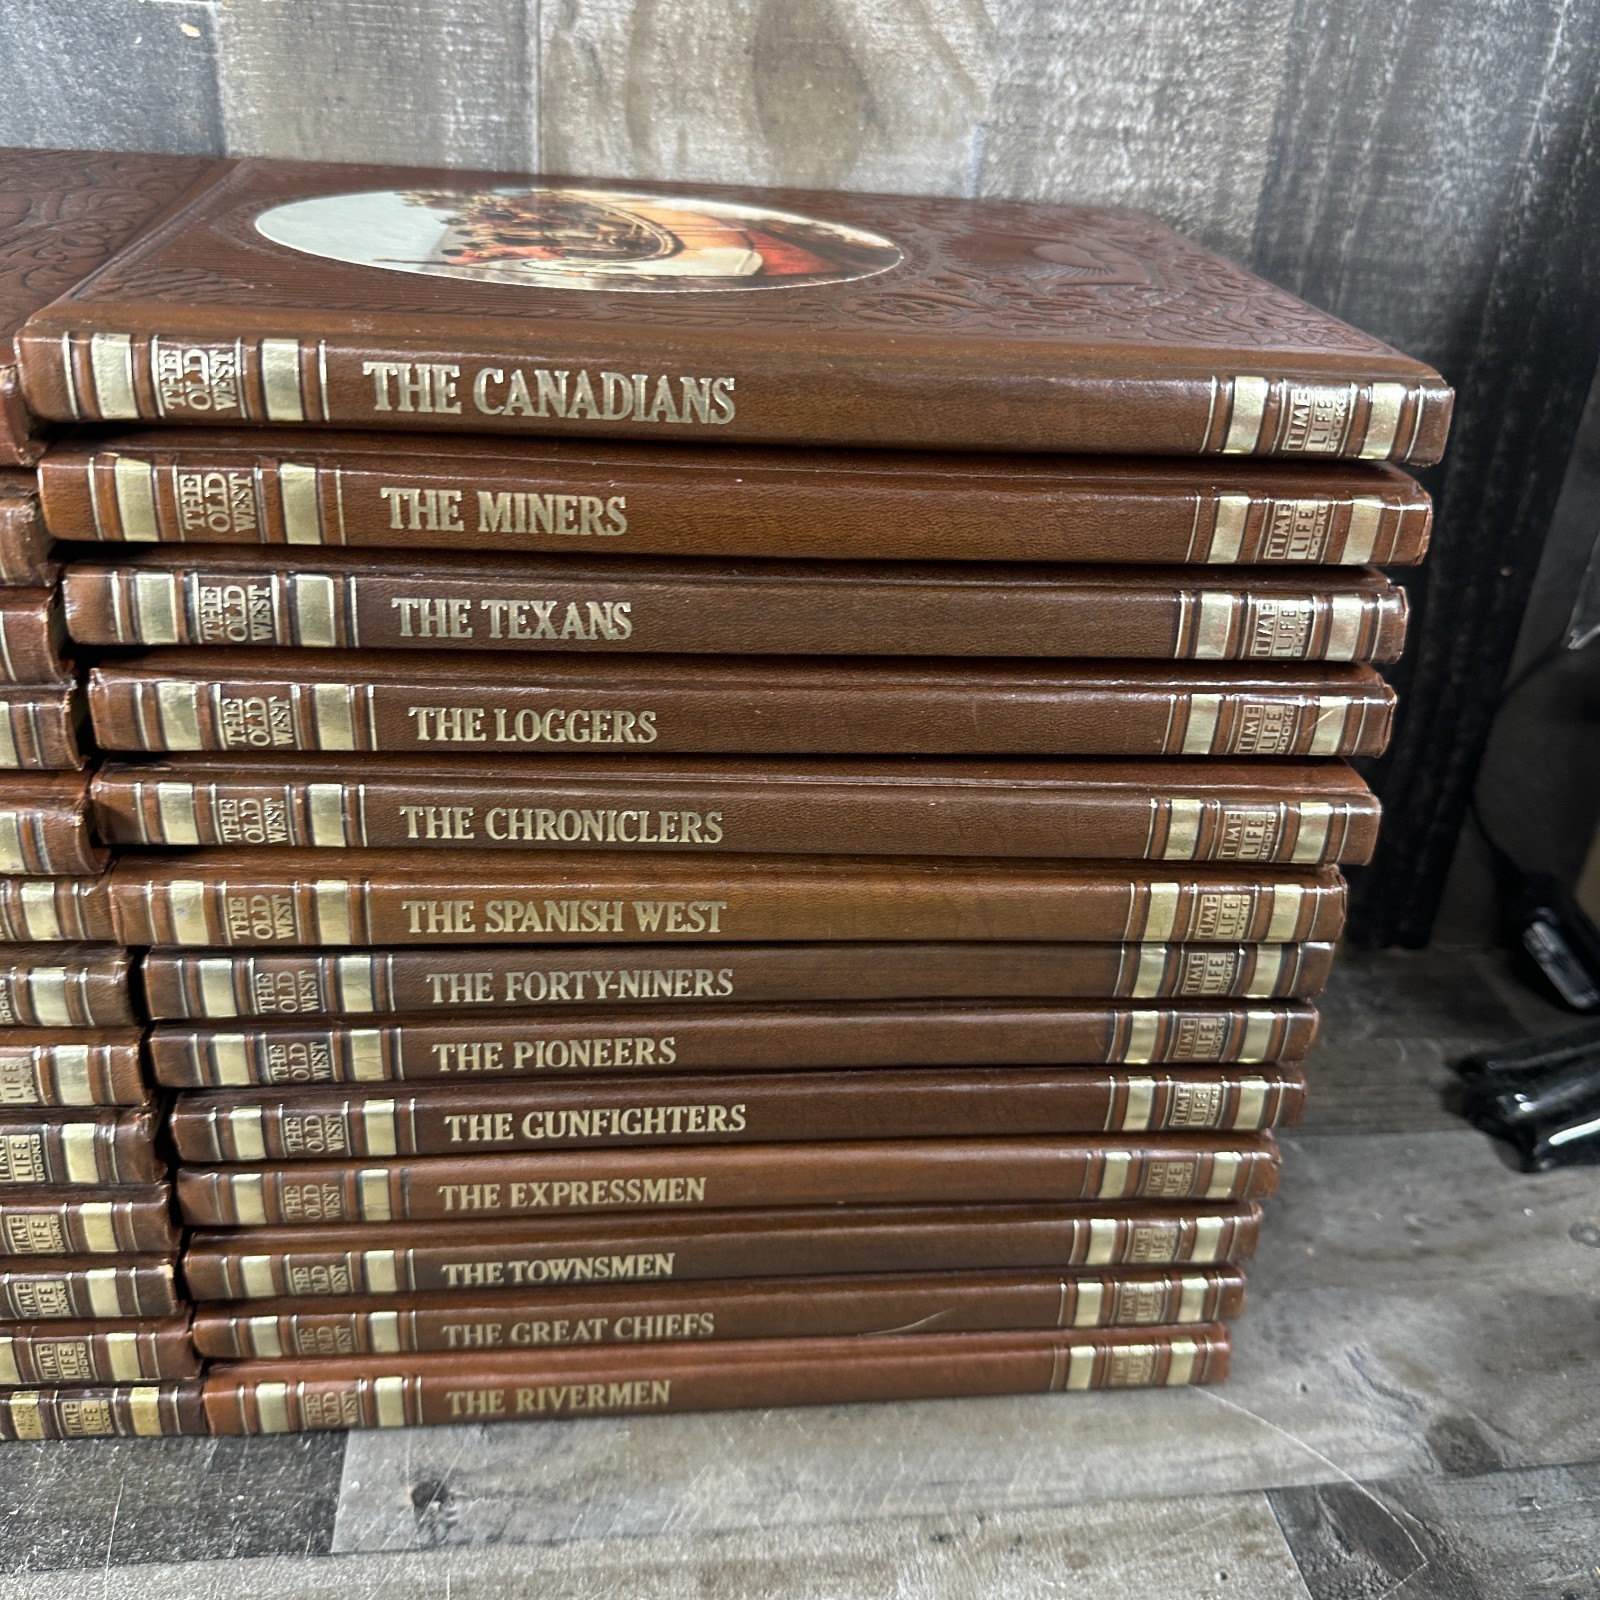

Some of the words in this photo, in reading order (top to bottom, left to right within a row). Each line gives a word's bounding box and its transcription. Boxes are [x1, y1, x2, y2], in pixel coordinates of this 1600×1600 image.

[159, 350, 187, 409] THE
[182, 349, 211, 410] OLD
[209, 350, 237, 410] WEST
[363, 361, 462, 415] THE
[472, 367, 736, 426] CANADIANS
[1284, 391, 1311, 450] TIME
[1307, 396, 1334, 448] LIFE
[179, 474, 205, 530] THE
[203, 472, 229, 532] OLD
[229, 472, 256, 532] WEST
[381, 487, 465, 533] THE
[477, 491, 628, 537] MINERS
[1266, 503, 1292, 559] TIME
[1289, 508, 1313, 556] LIFE
[200, 586, 224, 640] THE
[223, 585, 248, 641] OLD
[248, 584, 272, 641] WEST
[391, 597, 473, 640] THE
[481, 598, 634, 641] TEXANS
[1253, 602, 1277, 656] TIME
[1273, 606, 1298, 653] LIFE
[221, 699, 247, 746] THE
[245, 697, 270, 746] OLD
[268, 696, 293, 746] WEST
[408, 706, 487, 743] THE
[493, 708, 659, 745] LOGGERS
[1239, 706, 1263, 753] TIME
[1258, 710, 1282, 752] LIFE
[220, 798, 242, 842] THE
[240, 798, 265, 843] OLD
[264, 797, 287, 843] WEST
[399, 805, 476, 841] THE
[484, 806, 725, 845] CHRONICLERS
[1221, 813, 1242, 859] TIME
[1240, 818, 1265, 858] LIFE
[229, 897, 250, 939] THE
[251, 895, 273, 940] OLD
[272, 895, 295, 939] WEST
[402, 900, 480, 935] THE
[485, 901, 624, 935] SPANISH
[631, 900, 728, 934] WEST
[1198, 895, 1219, 939] TIME
[1217, 899, 1239, 937] LIFE
[255, 973, 276, 1012] THE
[277, 971, 298, 1012] OLD
[298, 970, 320, 1012] WEST
[426, 971, 498, 1003] THE
[504, 968, 734, 1002] FORTY-NINERS
[1184, 954, 1205, 993] TIME
[1203, 957, 1225, 992] LIFE
[432, 1043, 505, 1073] THE
[512, 1036, 678, 1070] PIONEERS
[1175, 1019, 1197, 1057] TIME
[1193, 1021, 1216, 1057] LIFE
[268, 1044, 289, 1080] THE
[289, 1043, 310, 1080] OLD
[310, 1042, 330, 1079] WEST
[2, 1062, 25, 1100] LIFE
[444, 1113, 515, 1144] THE
[519, 1104, 748, 1141] GUNFIGHTERS
[1171, 1086, 1191, 1124] TIME
[1190, 1089, 1211, 1124] LIFE
[285, 1117, 303, 1151] THE
[304, 1114, 324, 1153] OLD
[324, 1114, 345, 1152] WEST
[10, 1138, 34, 1178] LIFE
[438, 1183, 503, 1212] THE
[509, 1176, 708, 1208] EXPRESSMEN
[1163, 1164, 1182, 1195] LIFE
[284, 1185, 303, 1219] THE
[303, 1184, 322, 1219] OLD
[322, 1183, 341, 1219] WEST
[10, 1216, 34, 1252] TIME
[31, 1218, 55, 1251] LIFE
[442, 1261, 504, 1288] THE
[507, 1253, 676, 1284] TOWNSMEN
[17, 1282, 39, 1316] TIME
[37, 1284, 60, 1315] LIFE
[442, 1321, 505, 1348] THE
[511, 1316, 608, 1342] GREAT
[614, 1312, 716, 1340] CHIEFS
[39, 1343, 61, 1378] TIME
[59, 1345, 81, 1377] LIFE
[445, 1388, 505, 1415] THE
[516, 1380, 672, 1410] RIVERMEN
[64, 1402, 86, 1434] TIME
[82, 1404, 105, 1434] LIFE
